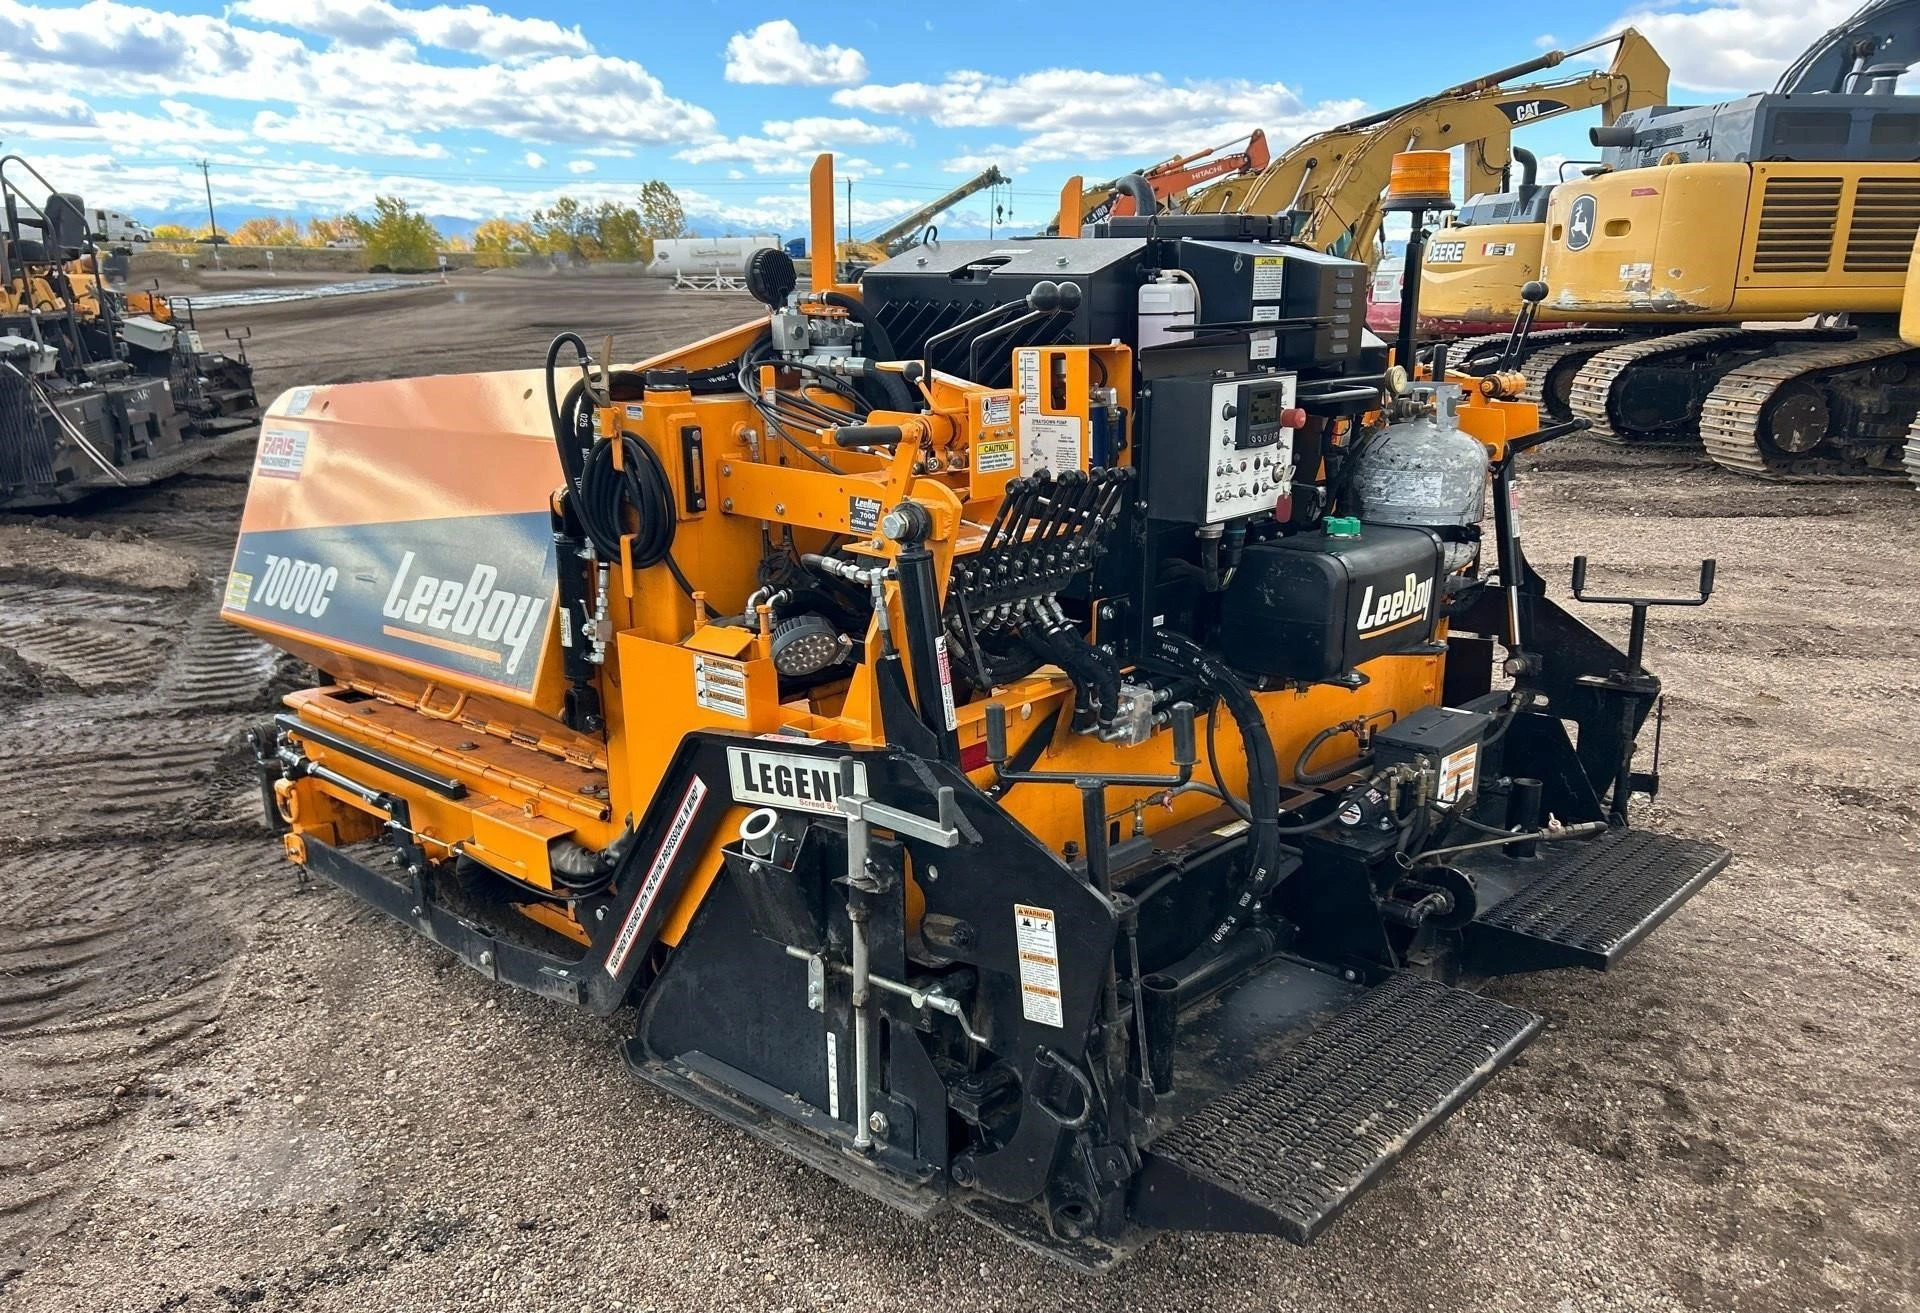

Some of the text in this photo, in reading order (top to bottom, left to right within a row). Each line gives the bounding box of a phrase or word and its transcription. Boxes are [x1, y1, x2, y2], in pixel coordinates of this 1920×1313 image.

[1516, 101, 1540, 121] CAT
[1191, 165, 1223, 181] HITACHI
[1427, 240, 1466, 263] DEERE
[262, 436, 296, 457] FARIS
[984, 443, 1009, 453] CAUTION
[854, 497, 881, 513] LeeBoy
[860, 512, 876, 520] 7000
[253, 554, 339, 618] 7000C
[1356, 572, 1434, 630] LeeBoy
[382, 551, 546, 675] LeeBoy
[799, 798, 825, 808] Screed
[625, 905, 643, 939] DESIGNED
[639, 889, 651, 912] WITH
[645, 878, 656, 898] THE
[651, 858, 666, 886] PAVING
[661, 815, 687, 863] PROFESSIONAL
[682, 805, 691, 819] IN
[1022, 908, 1052, 919] WARNING
